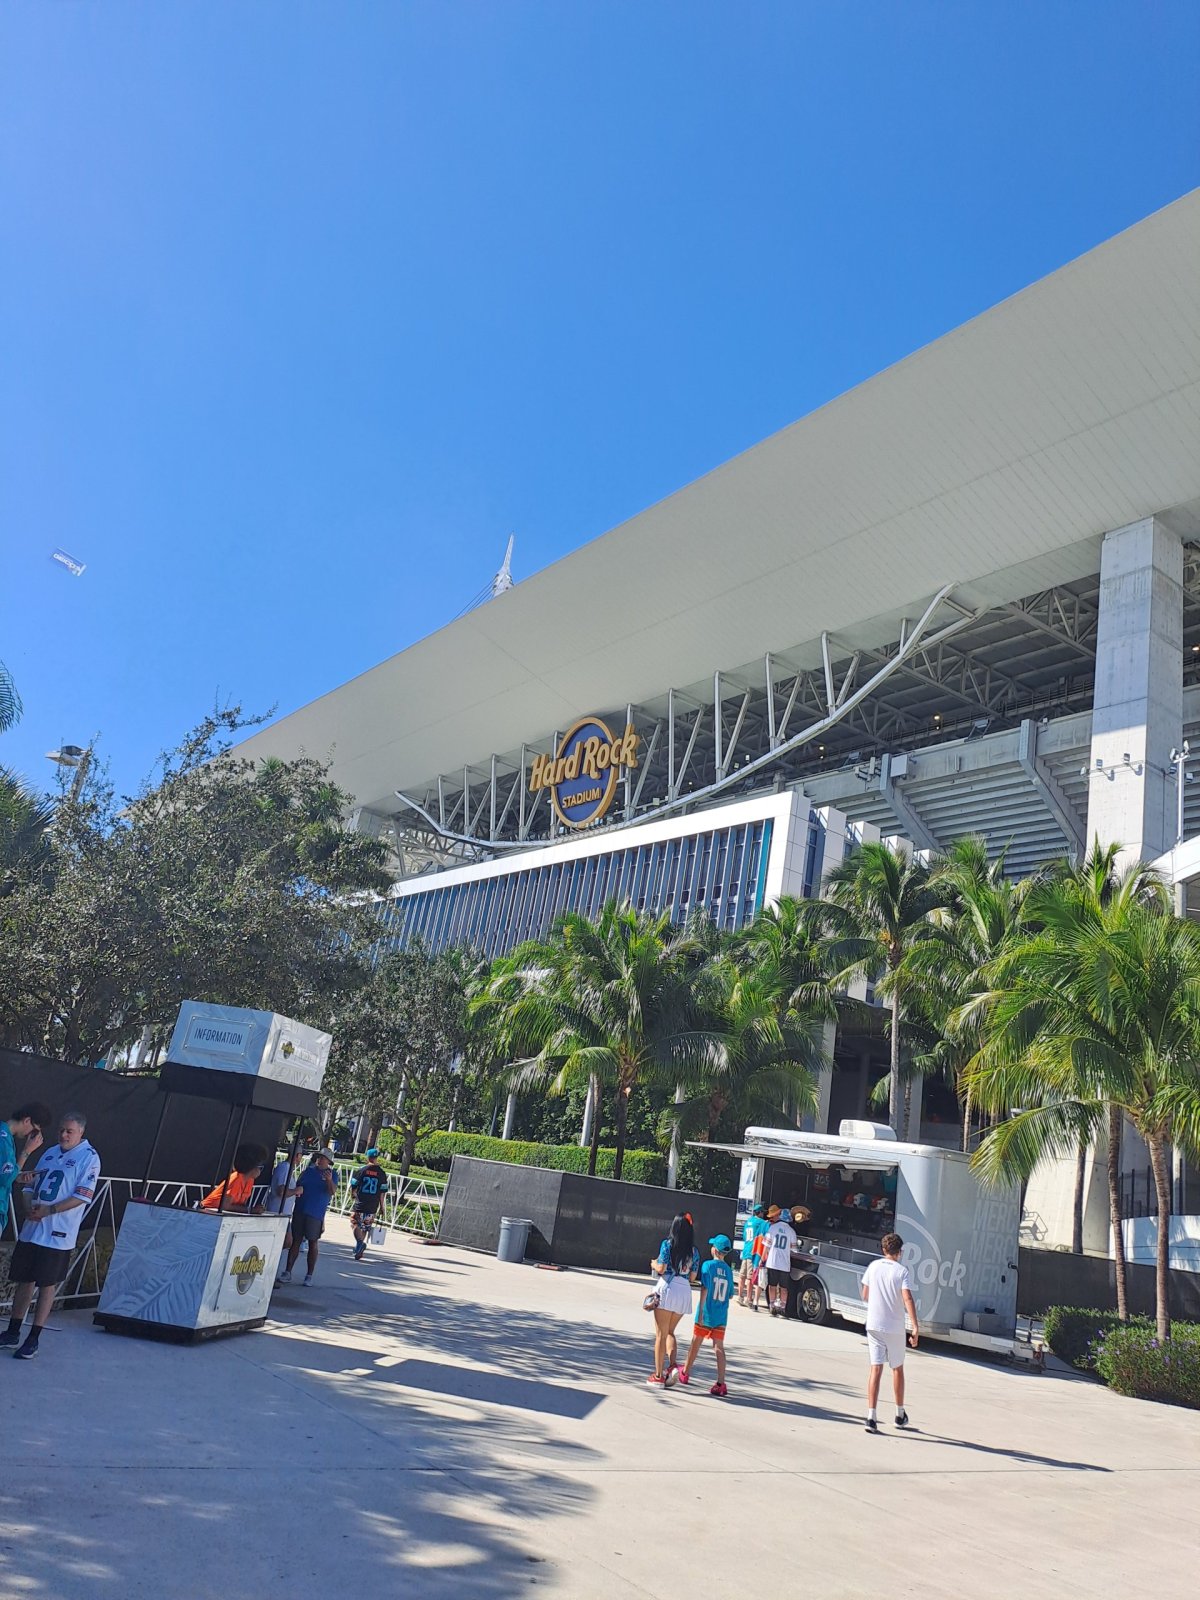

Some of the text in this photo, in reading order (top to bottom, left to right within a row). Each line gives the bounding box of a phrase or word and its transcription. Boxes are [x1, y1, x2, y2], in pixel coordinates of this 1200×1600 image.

[529, 722, 640, 791] Hard Rock
[562, 787, 603, 809] STADIUM
[194, 1027, 243, 1046] INFORMATION
[362, 1176, 379, 1194] 28
[774, 1233, 788, 1250] 10
[899, 1241, 967, 1297] Rock
[713, 1277, 728, 1302] 10
